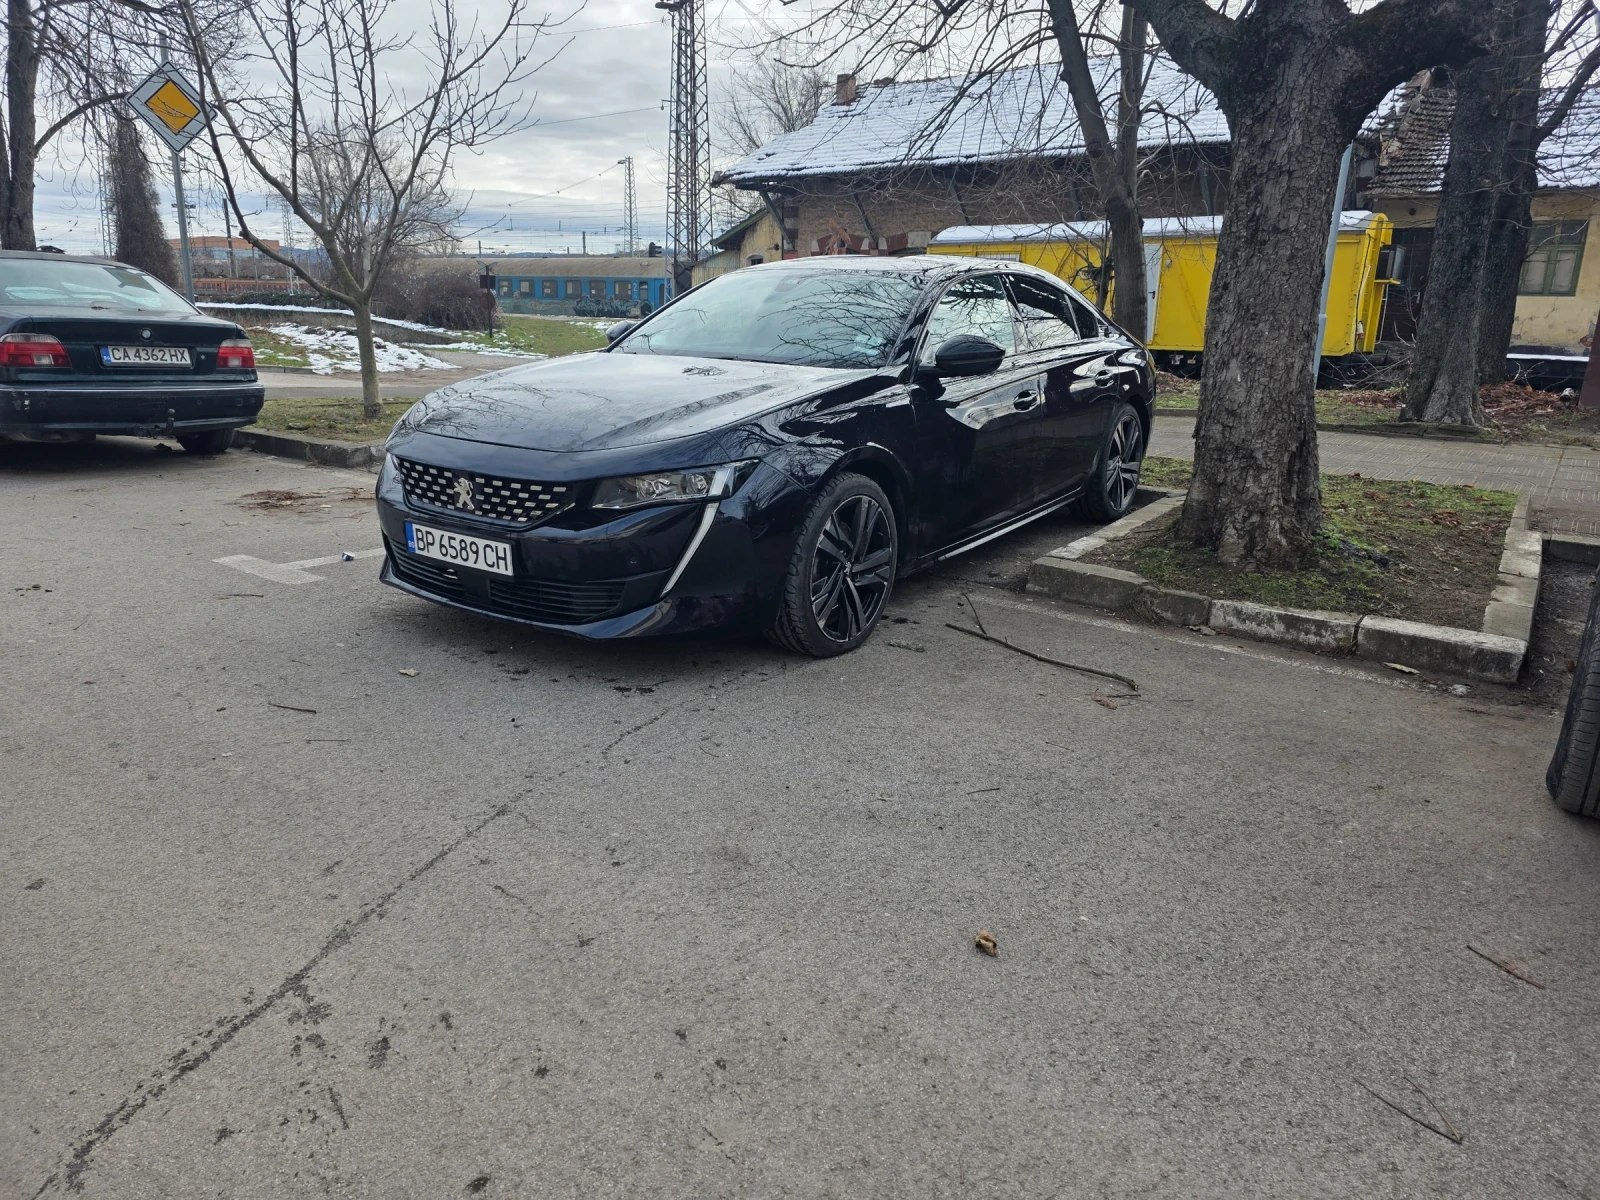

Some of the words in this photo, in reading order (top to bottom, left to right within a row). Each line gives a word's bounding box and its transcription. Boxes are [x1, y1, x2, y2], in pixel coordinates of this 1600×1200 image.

[111, 347, 131, 361] CA
[134, 348, 167, 361] 4362
[169, 348, 187, 362] HX
[415, 528, 435, 553] BP
[439, 534, 479, 565] 6589
[483, 544, 508, 572] CH
